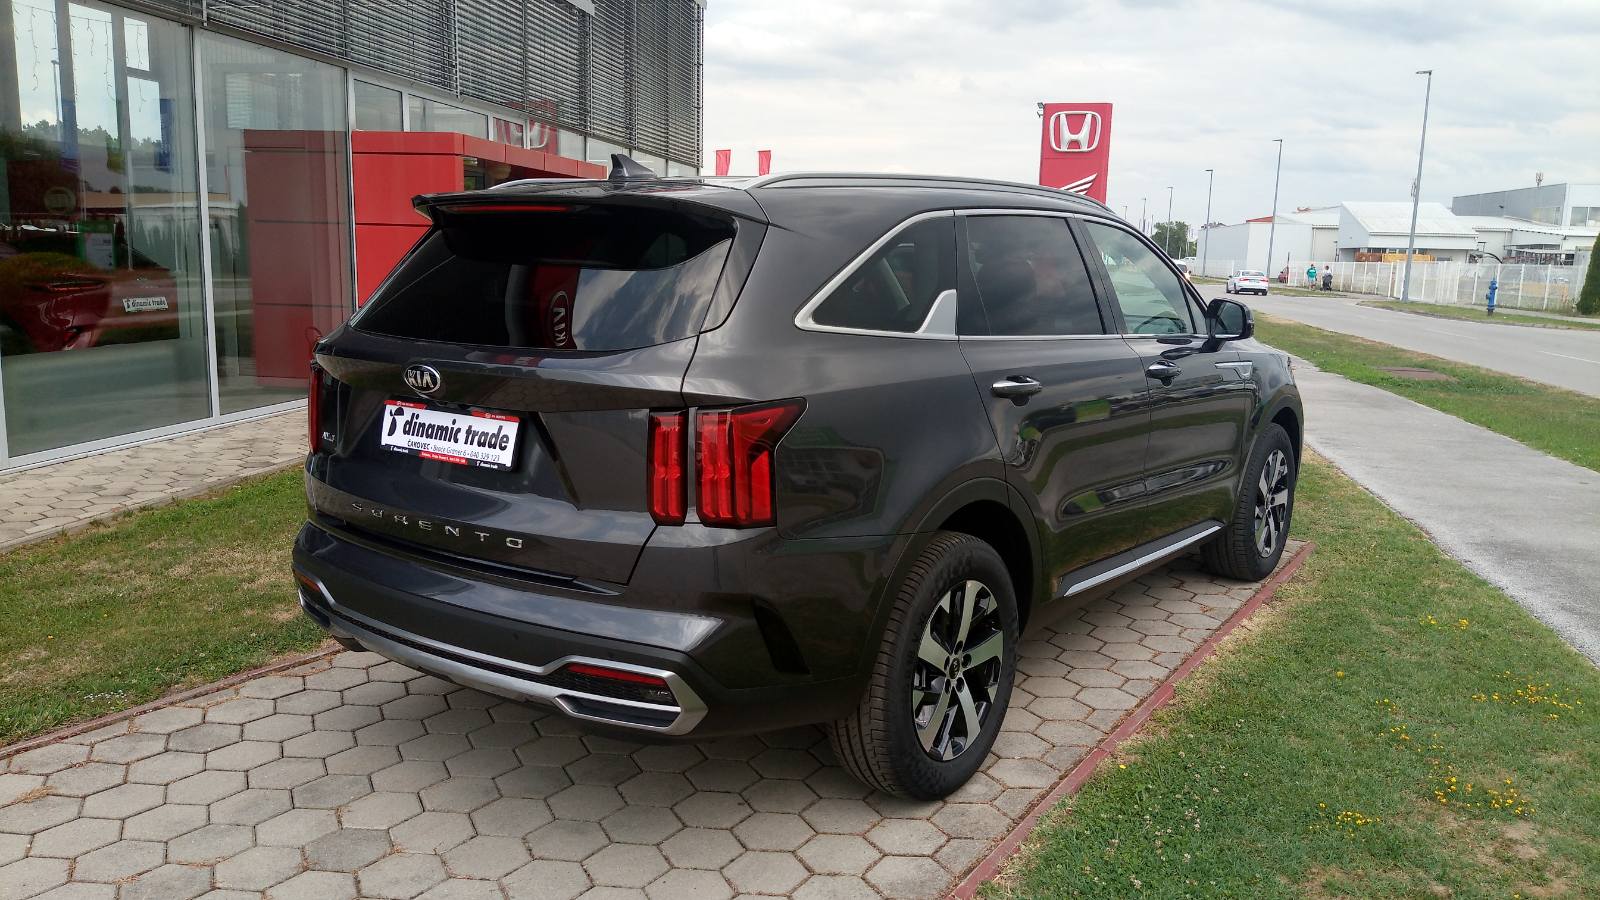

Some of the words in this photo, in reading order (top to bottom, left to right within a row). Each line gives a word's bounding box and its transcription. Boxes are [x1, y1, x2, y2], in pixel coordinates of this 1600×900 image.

[407, 369, 434, 388] KIA
[403, 413, 461, 444] dinamic
[464, 424, 510, 451] trade
